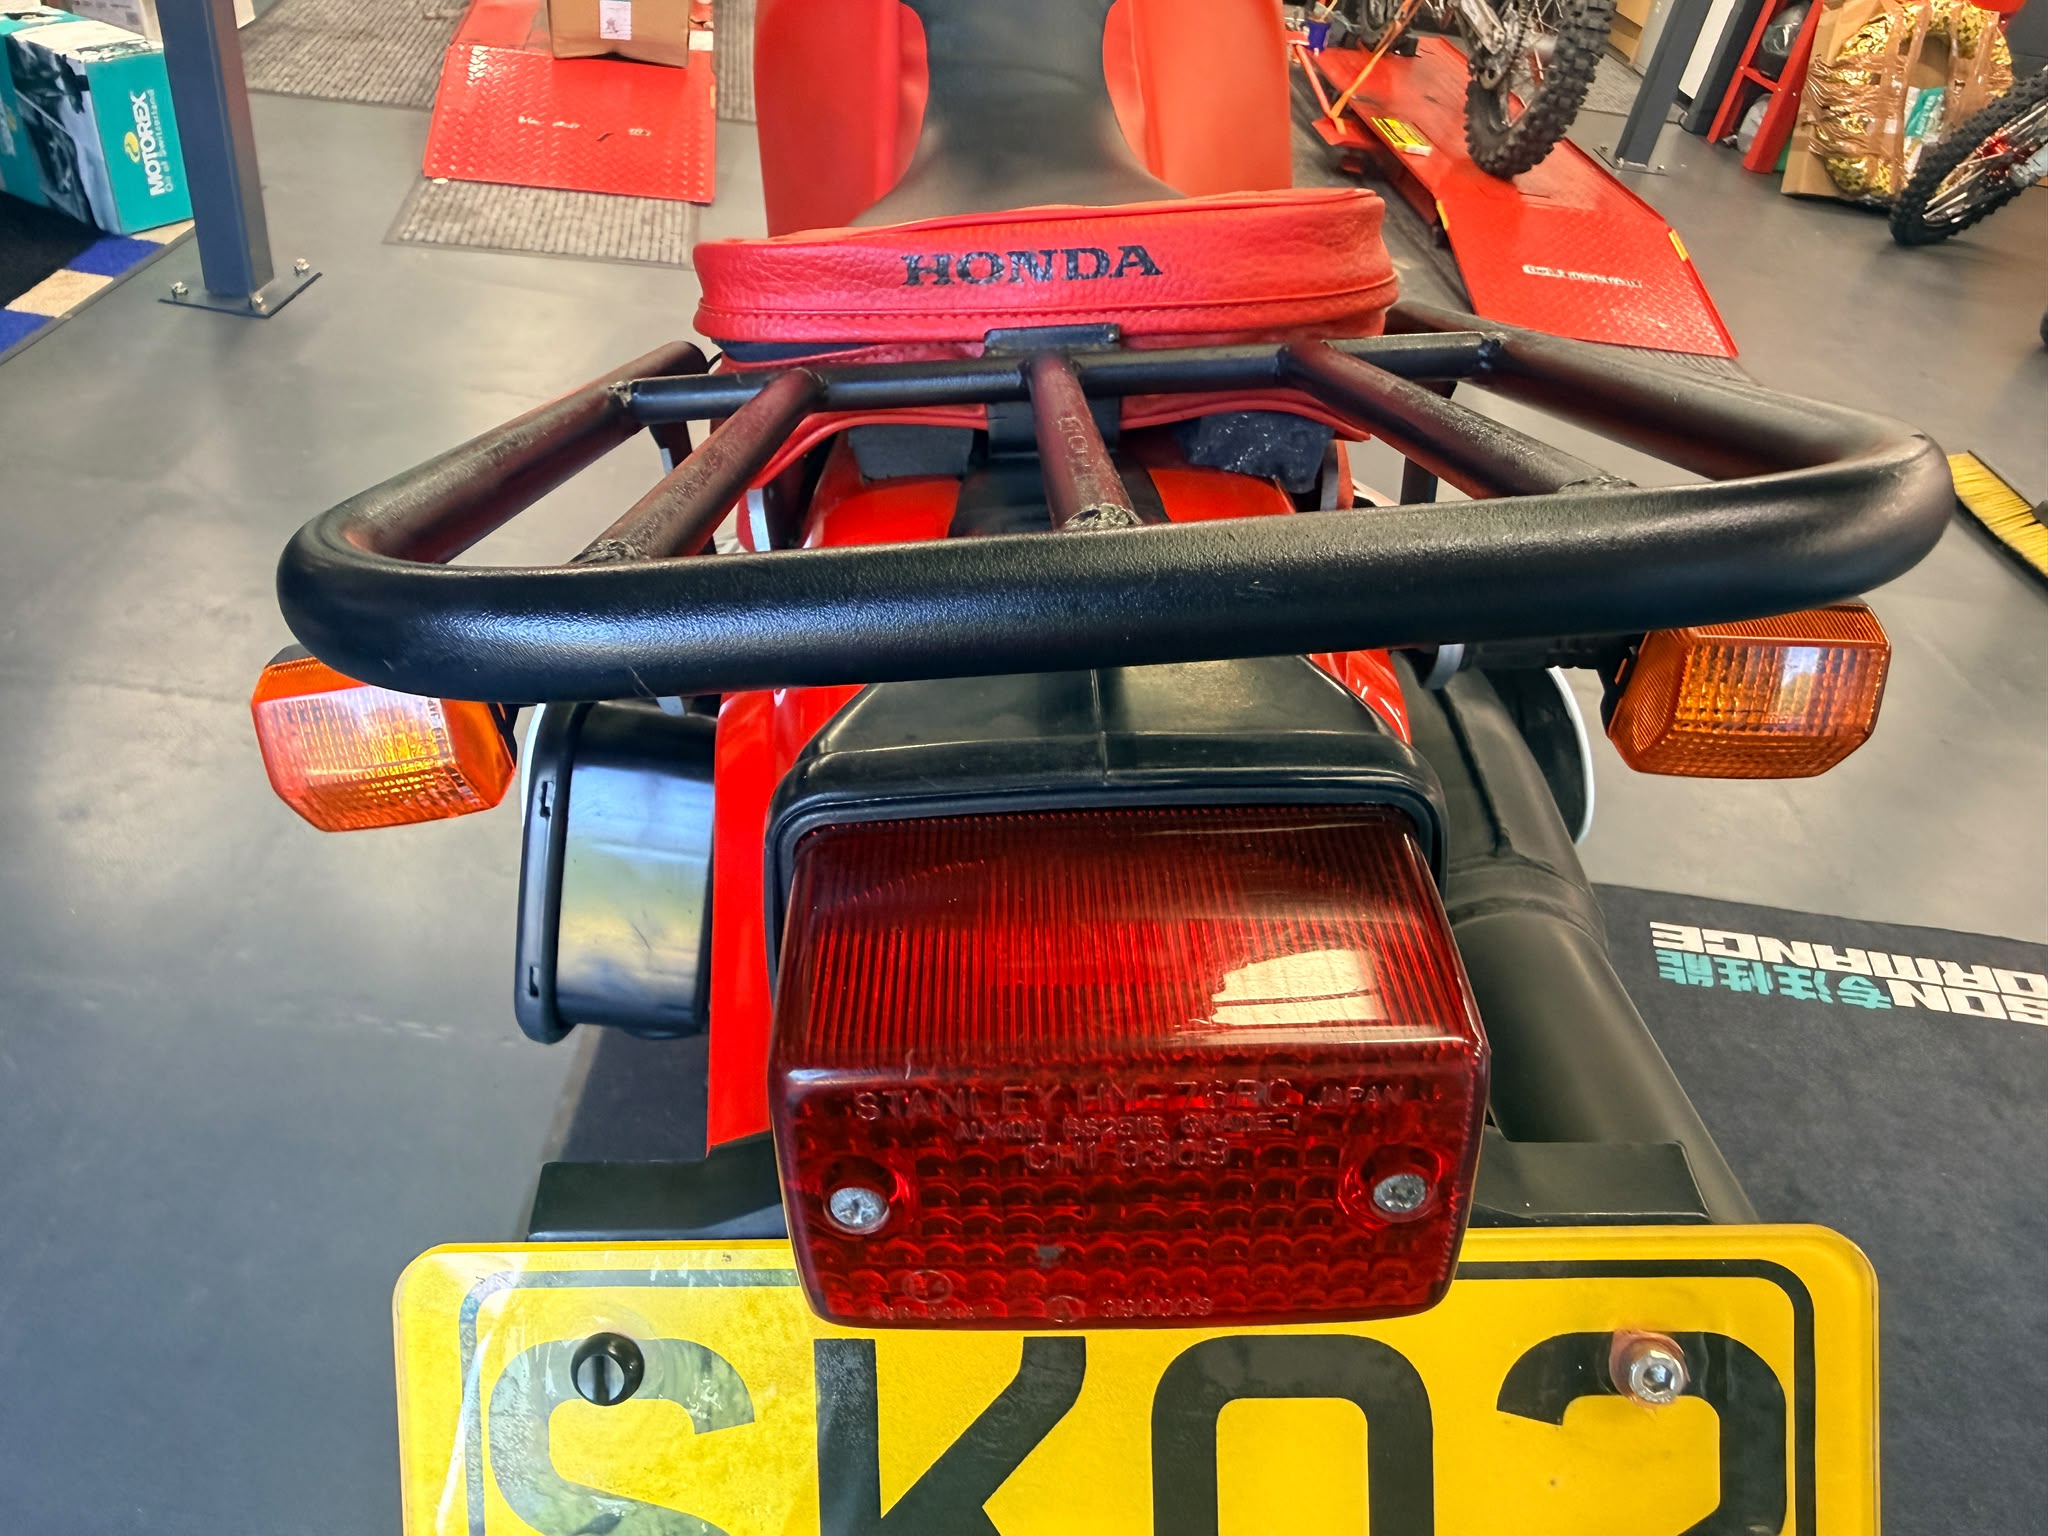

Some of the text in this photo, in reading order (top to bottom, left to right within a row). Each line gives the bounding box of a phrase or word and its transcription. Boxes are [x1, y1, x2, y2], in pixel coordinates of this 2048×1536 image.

[130, 91, 166, 196] MOTOREX
[901, 245, 1163, 286] HONDA
[1655, 949, 1893, 1009] 专注性能
[854, 1083, 1061, 1121] STANLEY
[1307, 1085, 1403, 1108] JAPAN
